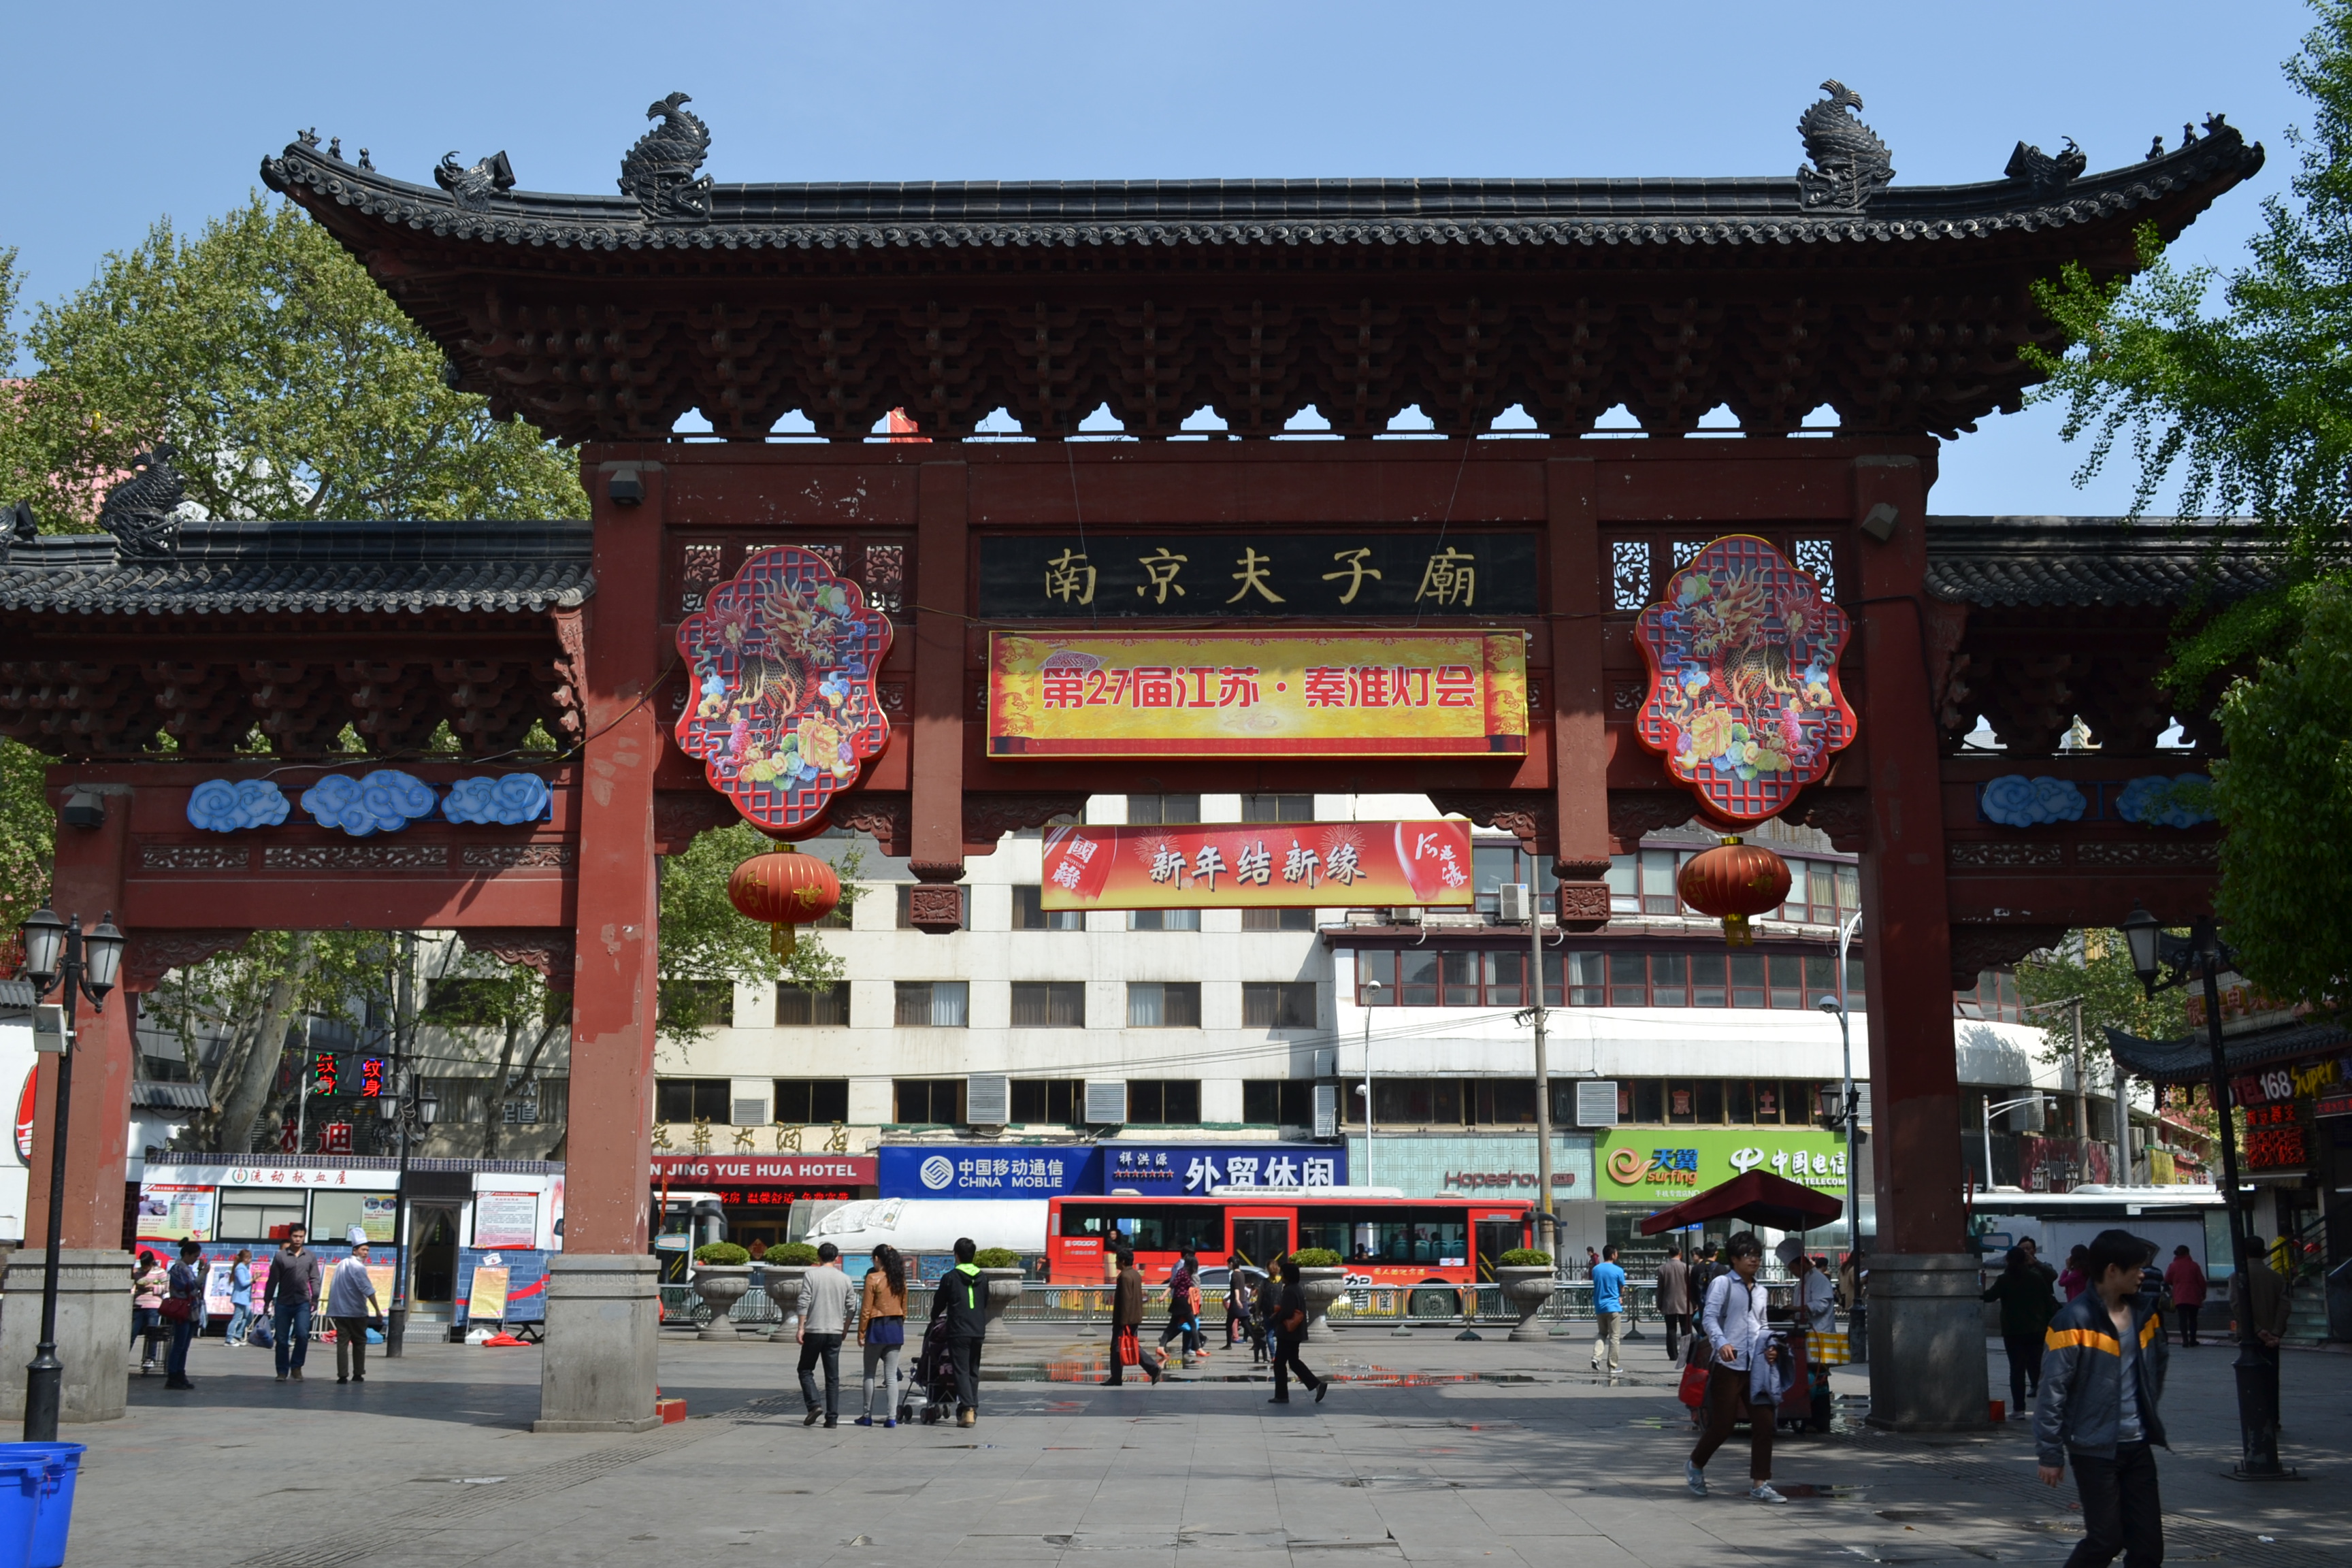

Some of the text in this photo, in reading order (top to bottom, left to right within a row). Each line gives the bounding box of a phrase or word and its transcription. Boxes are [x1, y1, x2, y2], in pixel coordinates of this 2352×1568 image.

[1045, 546, 1475, 606] 南京夫子廟
[1064, 855, 1087, 870] GUOYUAN
[1148, 839, 1366, 892] 新年结新缘
[363, 1060, 382, 1097] 纹身
[2259, 1071, 2293, 1101] 168
[2291, 1059, 2338, 1100] Super
[958, 1159, 1064, 1176] 中国移动通信
[1120, 1152, 1169, 1166] 祥洪源
[1650, 1148, 1698, 1171] 天翼
[1771, 1149, 1846, 1175] 中国电信
[250, 1169, 346, 1186] 流动献血屋
[667, 1164, 709, 1177] JING
[715, 1164, 750, 1177] YUE
[756, 1164, 794, 1177] HUA
[799, 1164, 857, 1177] HOTEL
[1185, 1156, 1334, 1192] 外贸休闲
[1647, 1169, 1698, 1185] surfing
[958, 1176, 1063, 1188] CHINA MOBLIE
[747, 1192, 795, 1204] 温馨舒适
